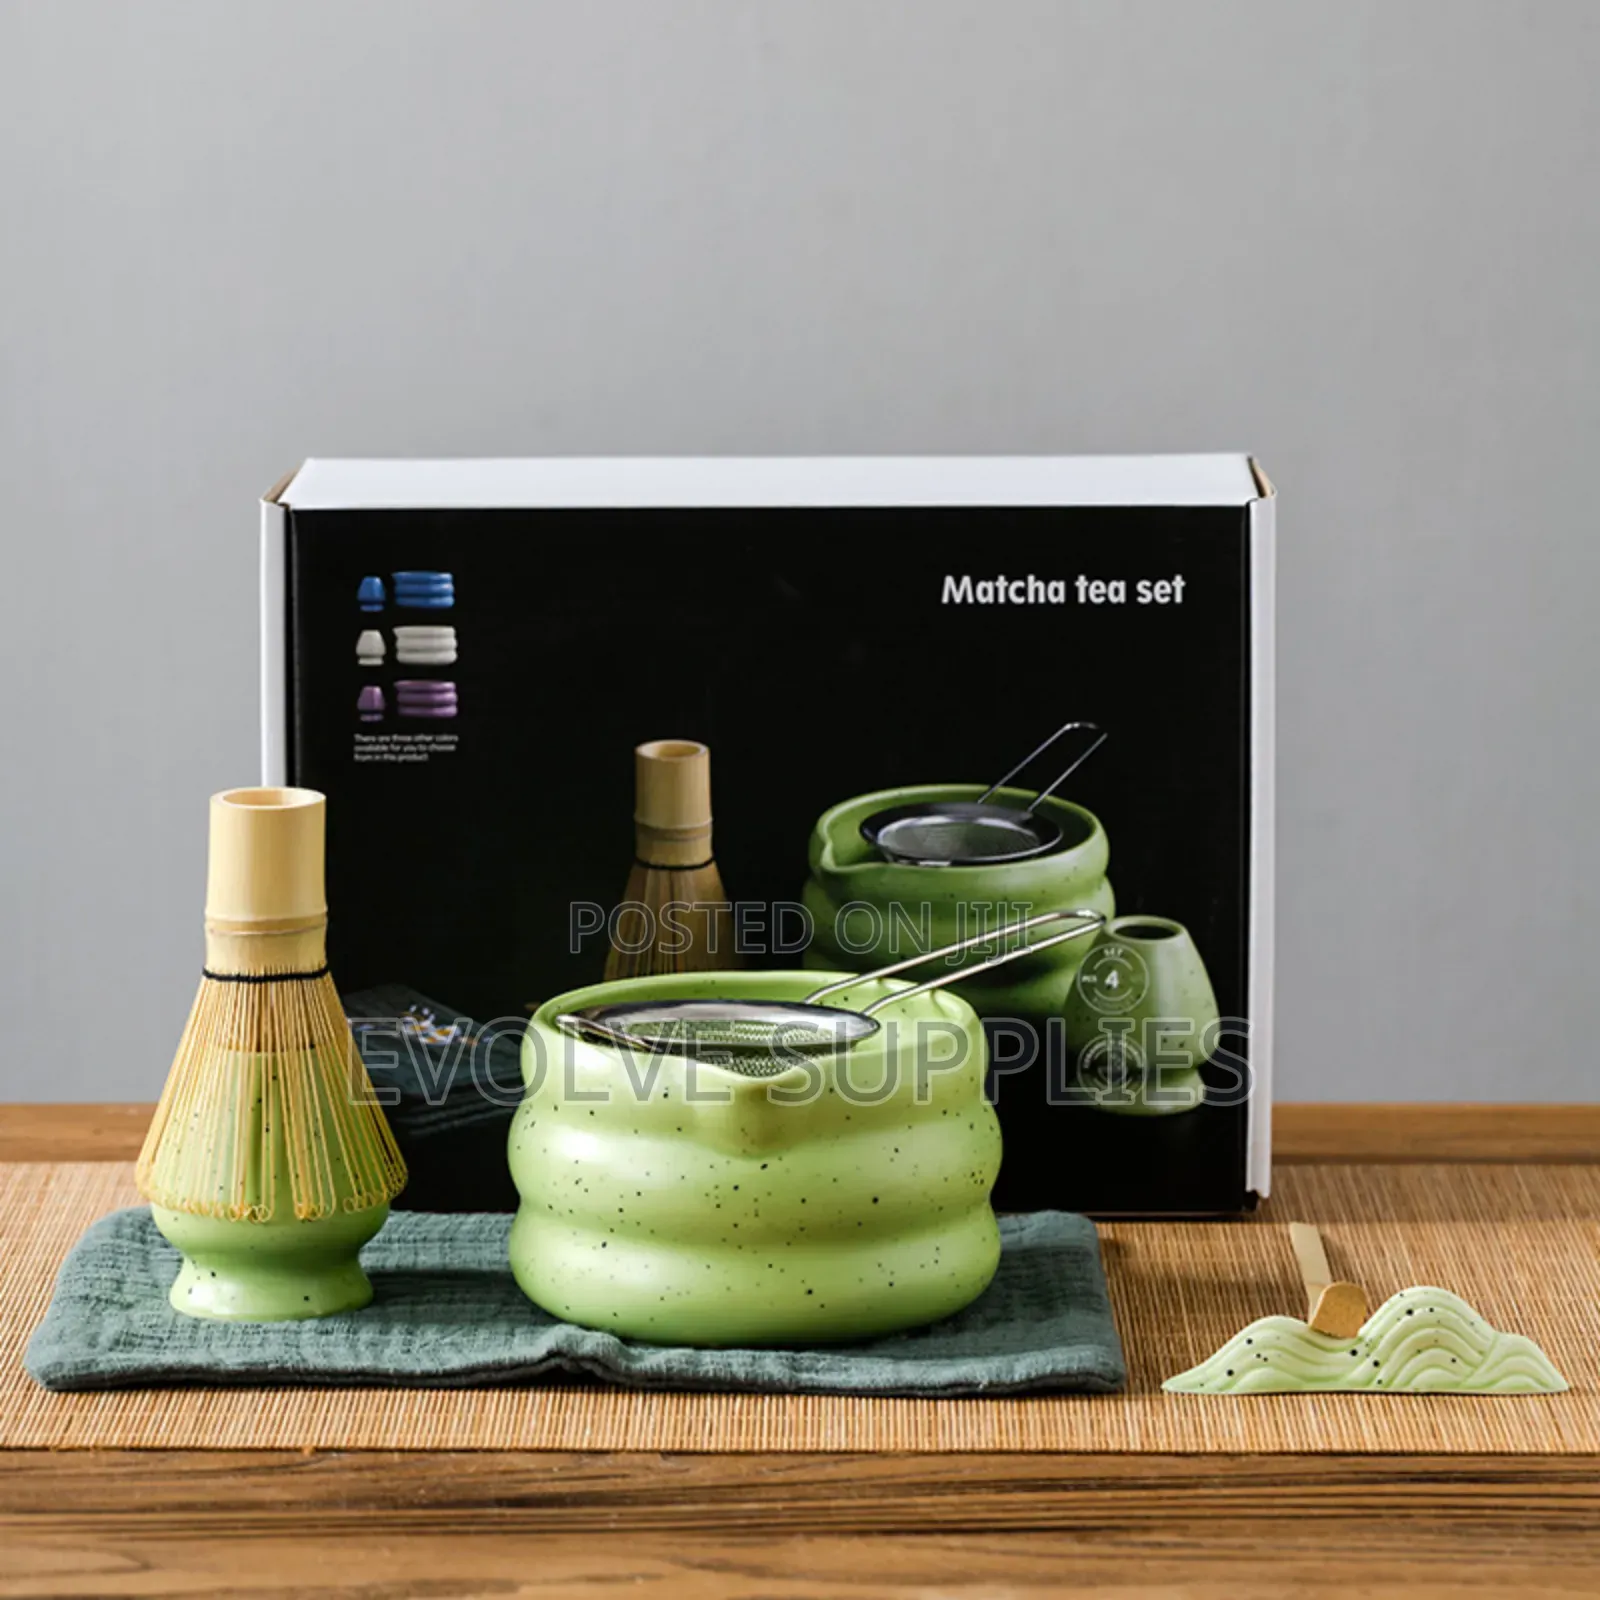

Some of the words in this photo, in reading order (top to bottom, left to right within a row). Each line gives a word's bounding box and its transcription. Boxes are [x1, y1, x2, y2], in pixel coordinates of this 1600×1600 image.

[941, 573, 1066, 605] Matcha
[1075, 573, 1127, 605] tea
[1135, 573, 1186, 605] set
[1104, 969, 1120, 989] 4
